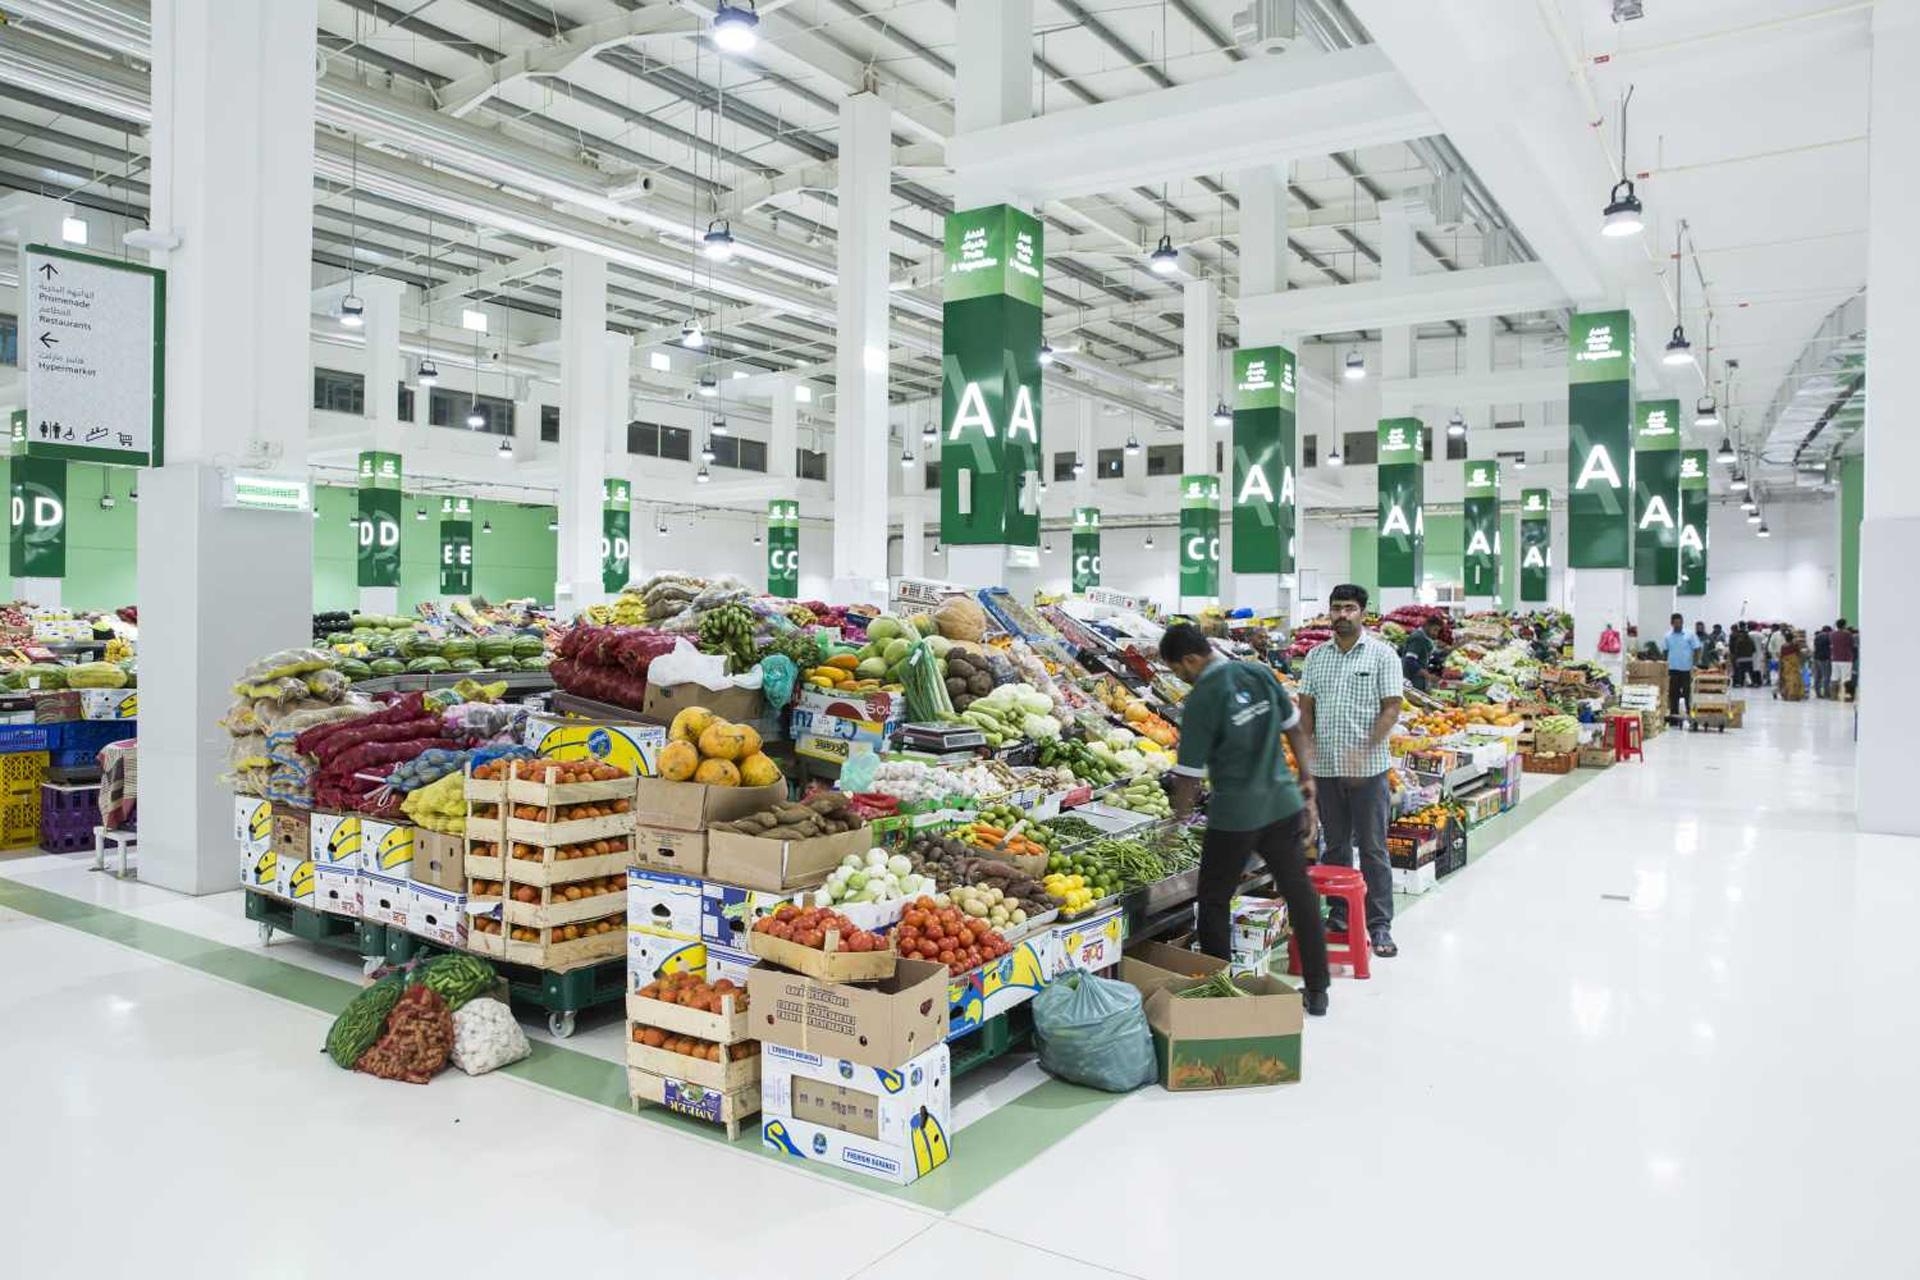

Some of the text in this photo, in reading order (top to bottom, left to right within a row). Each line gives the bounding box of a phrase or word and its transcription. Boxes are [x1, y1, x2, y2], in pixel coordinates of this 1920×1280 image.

[39, 292, 91, 308] Promenade
[39, 315, 91, 331] Restaurants
[38, 362, 96, 377] Hypermarket
[949, 381, 996, 440] A
[1008, 385, 1038, 444] A
[1575, 444, 1621, 490] A
[1238, 464, 1275, 504] A
[34, 496, 63, 527] D
[1382, 504, 1411, 536] A
[1639, 495, 1674, 529] A
[360, 521, 374, 546] D
[380, 521, 400, 546] D
[1467, 529, 1492, 556] A
[1679, 524, 1704, 552] A
[444, 545, 453, 565] E
[460, 545, 472, 565] E
[614, 537, 630, 560] D
[771, 550, 785, 570] C
[1188, 537, 1206, 561] C
[1523, 545, 1546, 568] A
[1076, 555, 1090, 574] C
